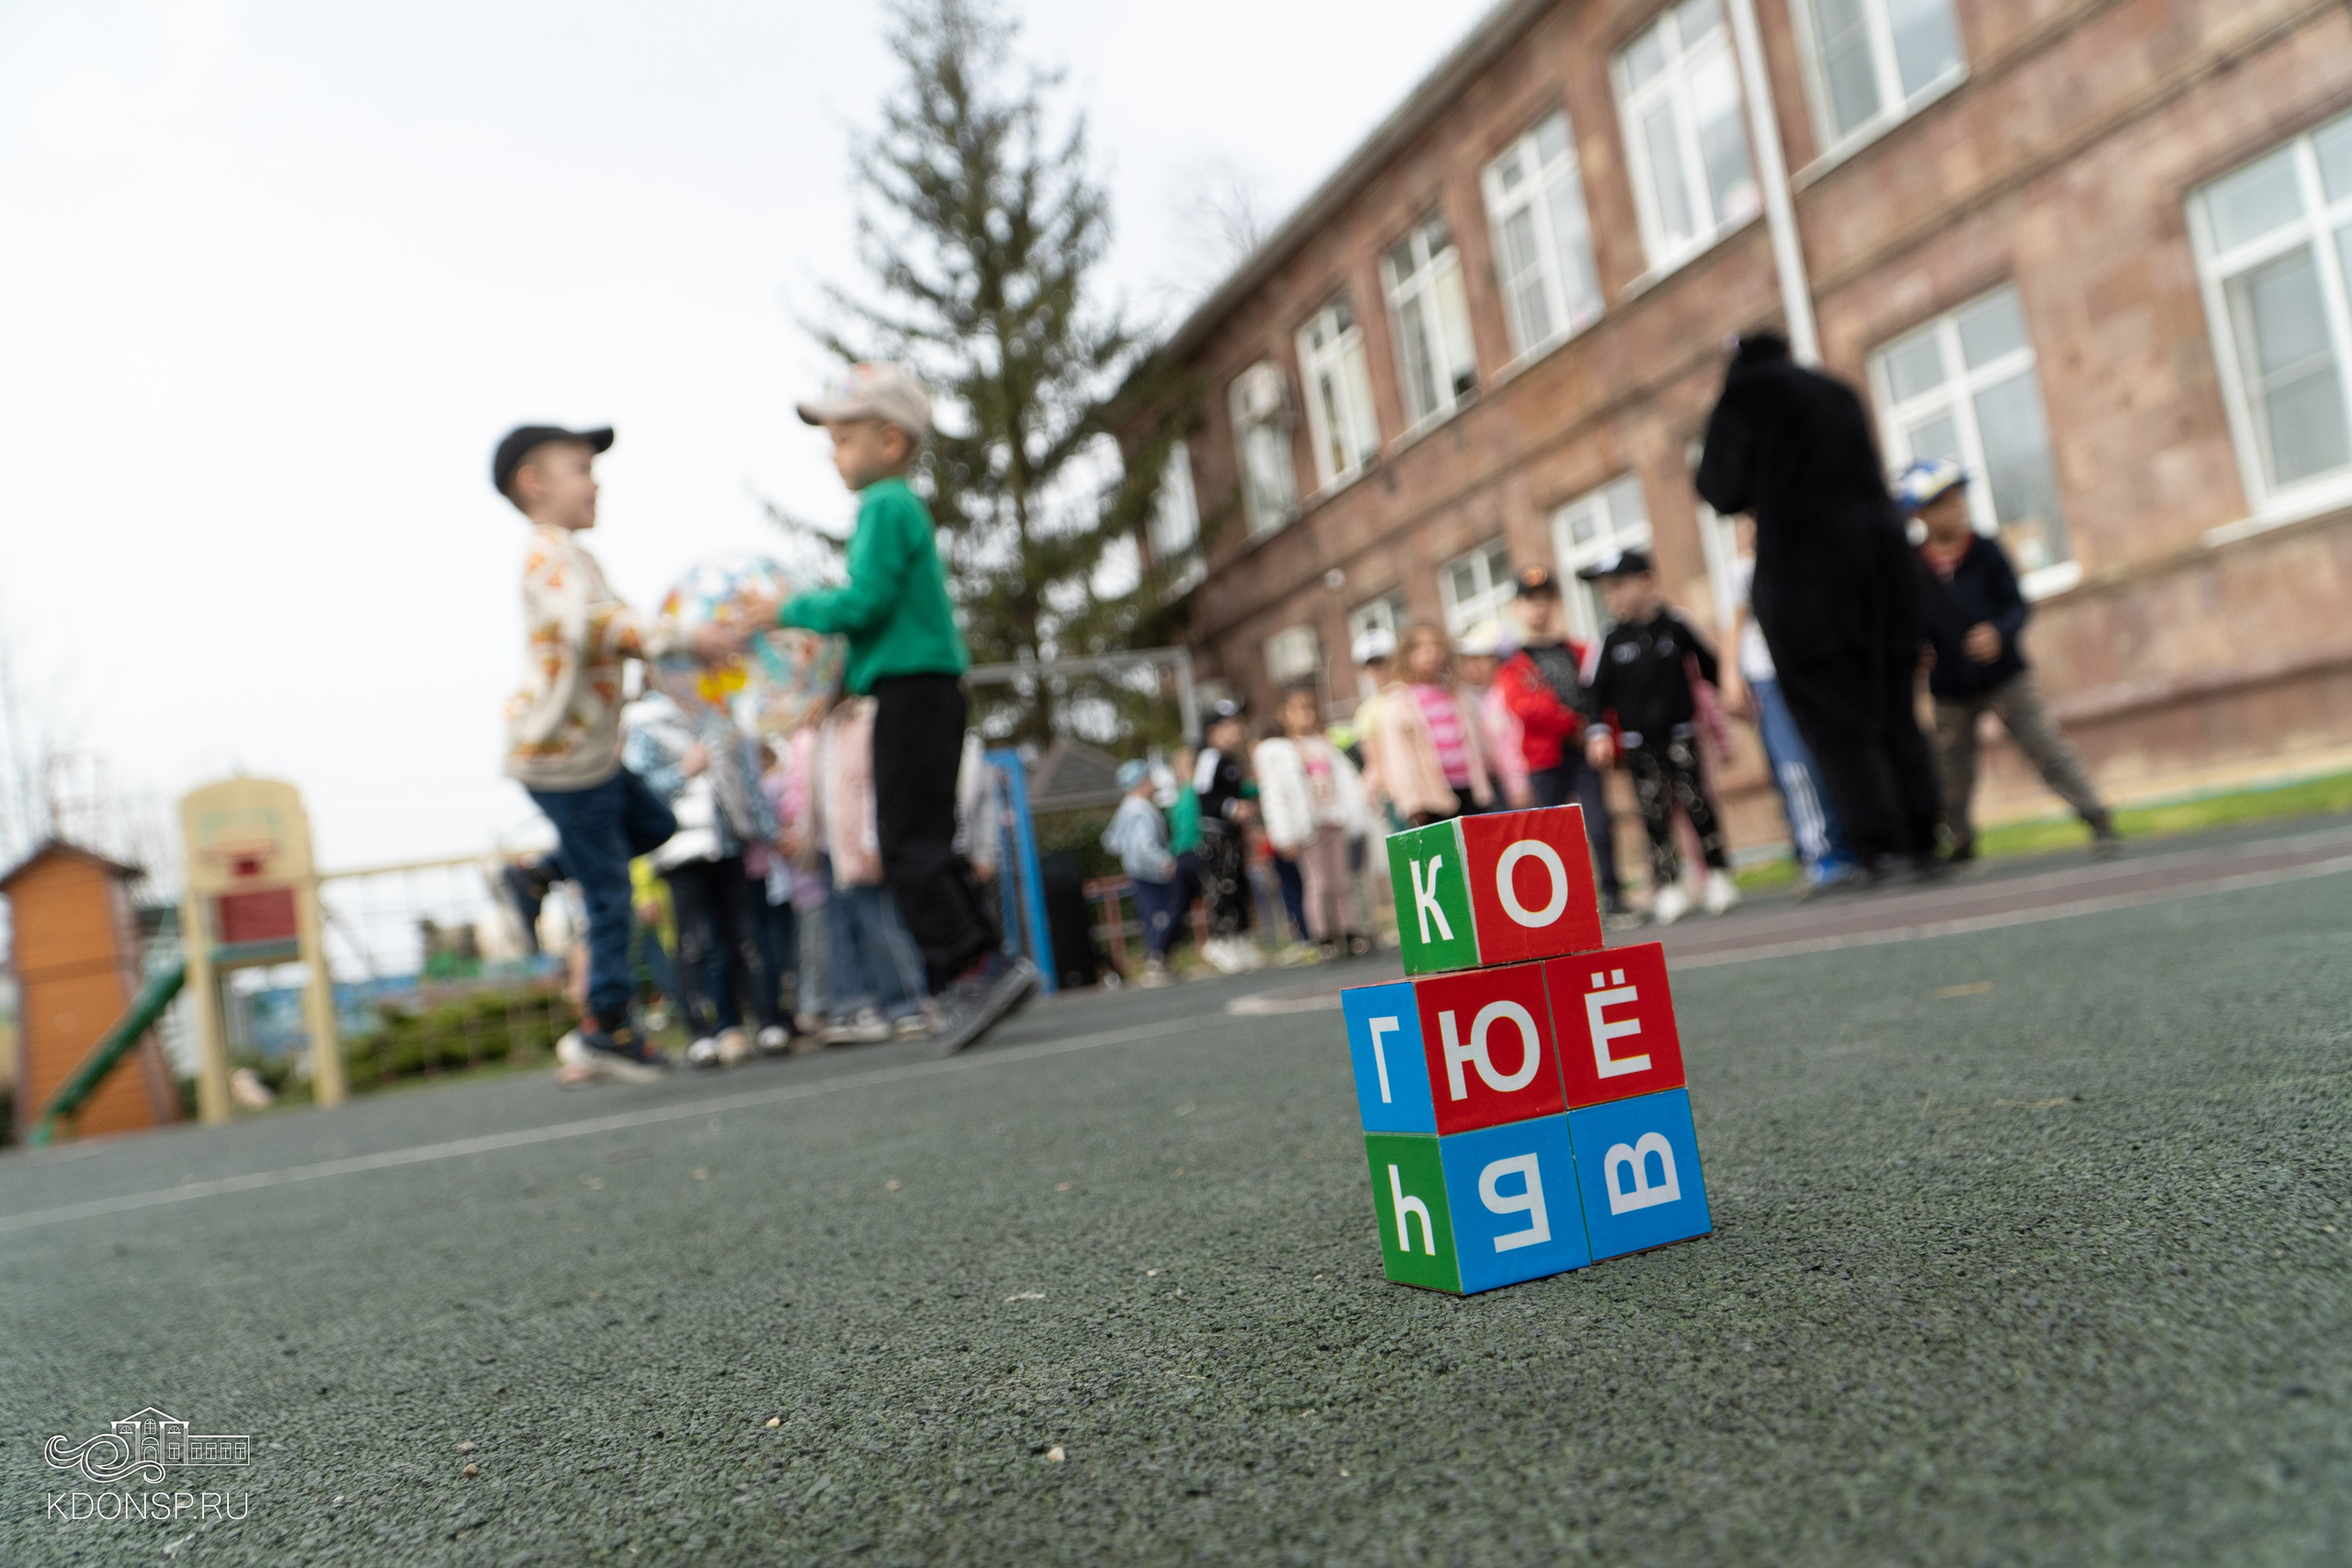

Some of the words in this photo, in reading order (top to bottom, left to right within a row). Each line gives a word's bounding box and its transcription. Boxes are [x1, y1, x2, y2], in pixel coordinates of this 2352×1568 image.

[1409, 853, 1454, 944] К
[1495, 839, 1569, 929] О
[1368, 1015, 1400, 1104] Г
[1438, 999, 1542, 1102] Ю
[1583, 967, 1653, 1080] Ё
